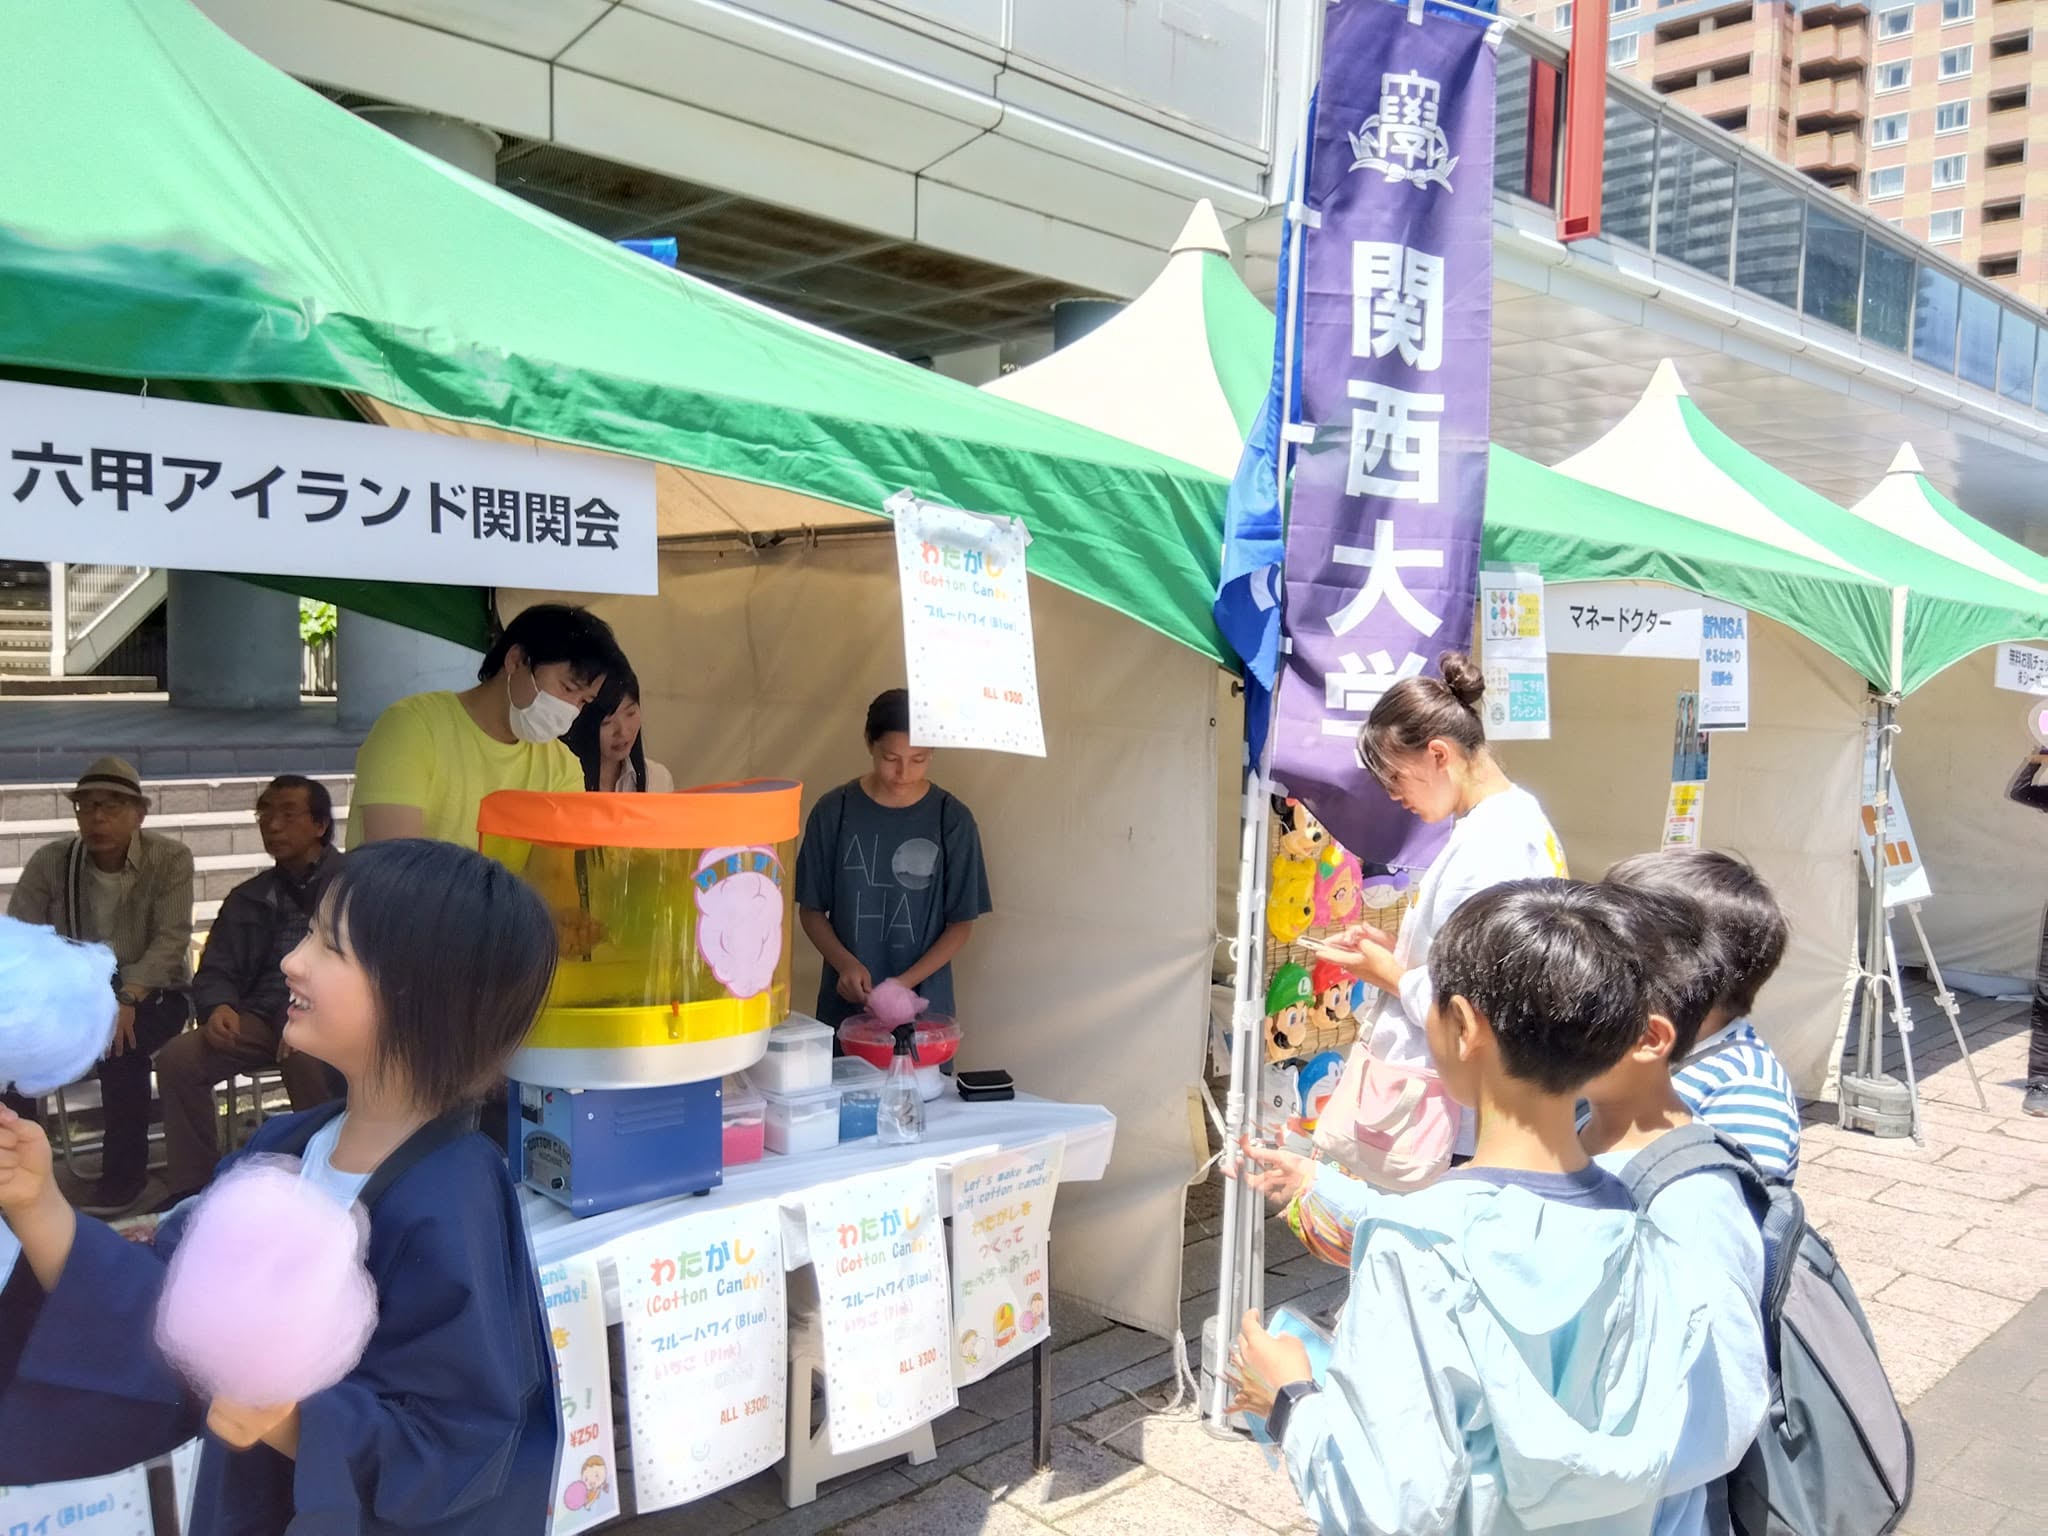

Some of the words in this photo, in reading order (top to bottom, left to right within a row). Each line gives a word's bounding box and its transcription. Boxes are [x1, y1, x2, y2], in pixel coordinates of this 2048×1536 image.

[11, 441, 621, 550] 六甲アイランド関関会
[1569, 604, 1672, 634] マネードクター
[836, 1206, 921, 1249] わたがし
[650, 1238, 756, 1287] わたがし
[836, 1250, 887, 1277] (Cotton
[546, 1279, 589, 1309] andy!
[646, 1287, 708, 1317] (Cotton
[716, 1271, 765, 1297] Candy)
[900, 1358, 914, 1374] ALL
[918, 1347, 938, 1368] ¥300
[720, 1406, 739, 1425] ALL
[744, 1395, 770, 1417] ¥300
[570, 1423, 600, 1449] ¥250
